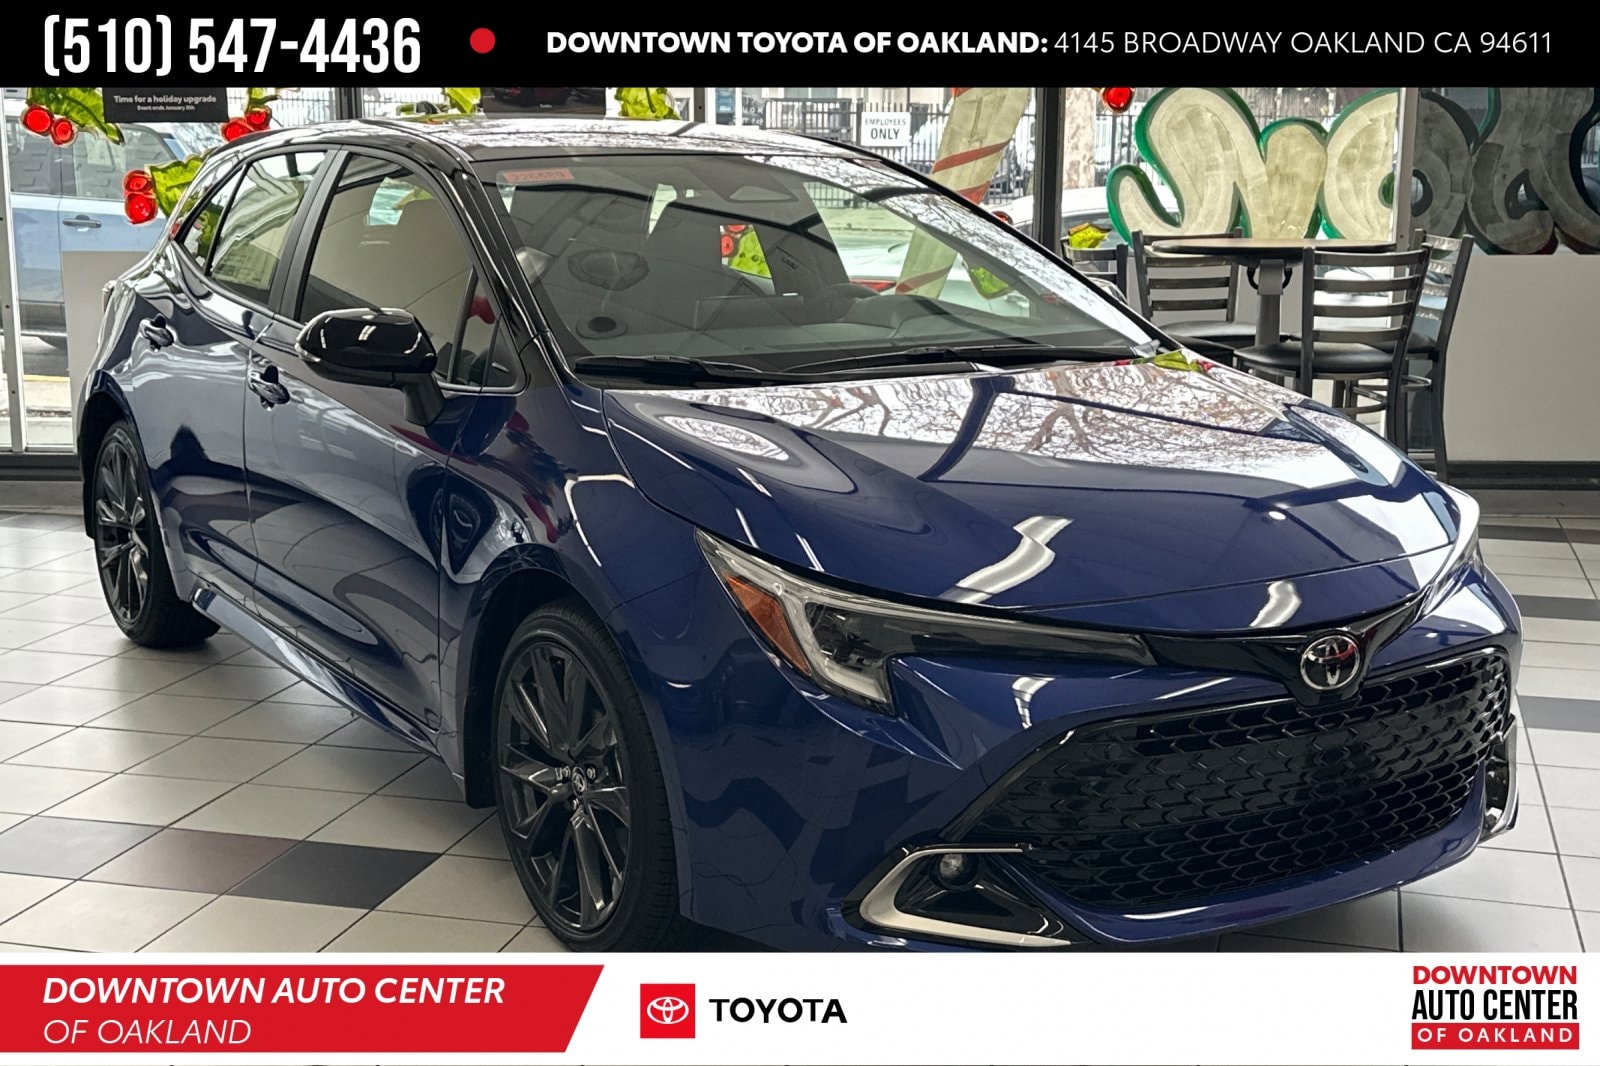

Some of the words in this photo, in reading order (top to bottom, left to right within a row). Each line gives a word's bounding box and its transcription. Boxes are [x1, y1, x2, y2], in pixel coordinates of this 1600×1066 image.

[113, 95, 133, 103] Time
[134, 95, 146, 103] for
[153, 95, 182, 104] holiday
[183, 95, 217, 104] upgrade
[864, 118, 906, 126] EMPLOYEES
[870, 127, 900, 140] ONLY
